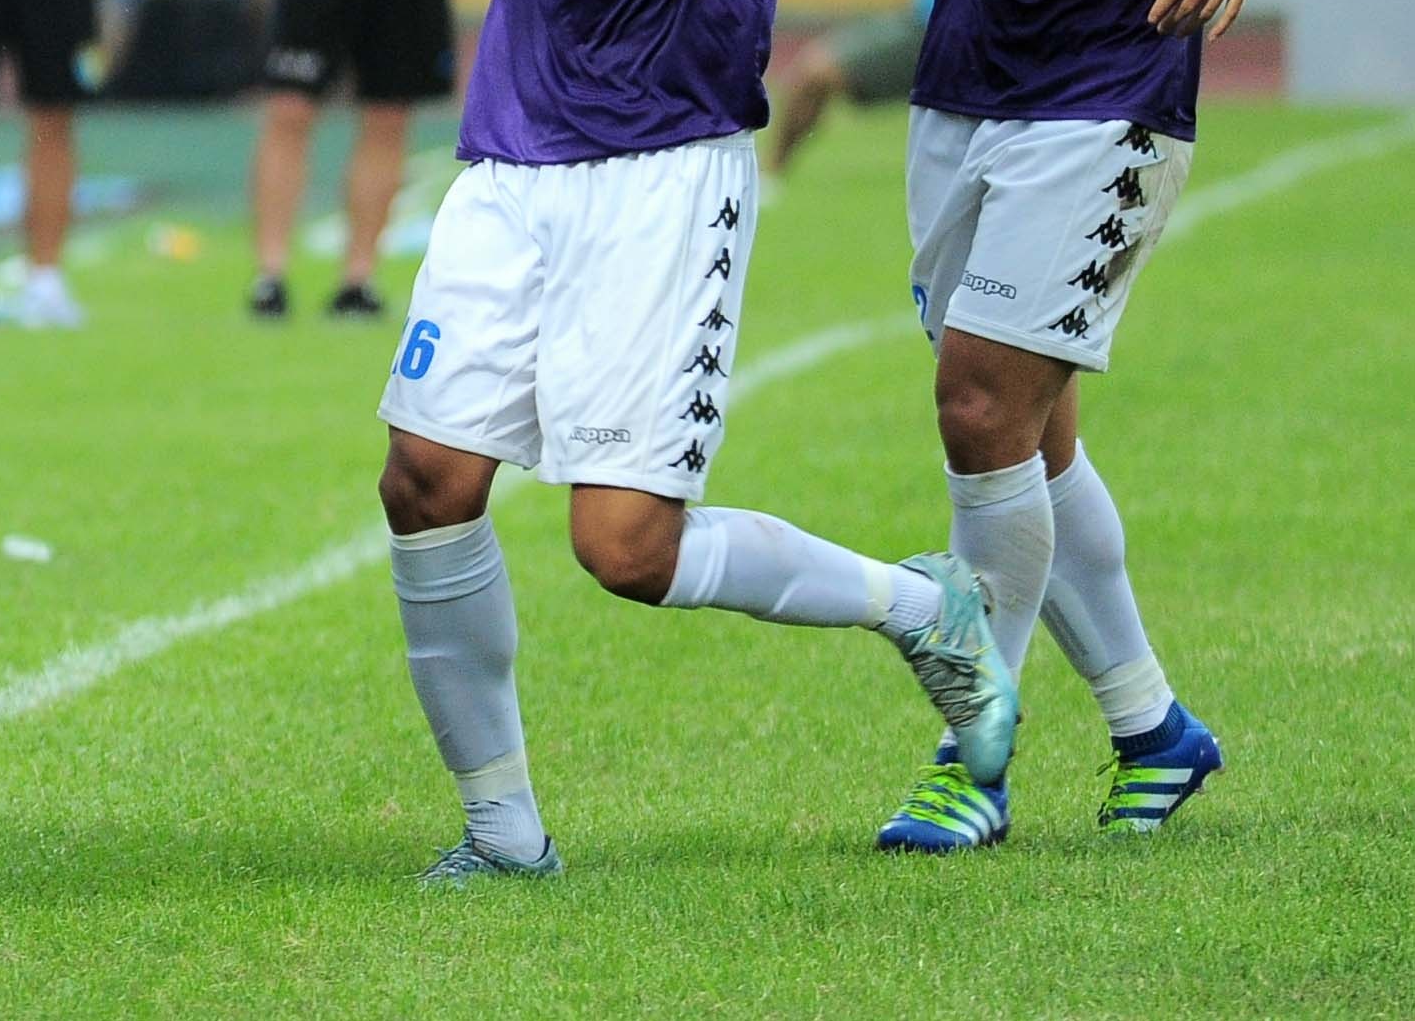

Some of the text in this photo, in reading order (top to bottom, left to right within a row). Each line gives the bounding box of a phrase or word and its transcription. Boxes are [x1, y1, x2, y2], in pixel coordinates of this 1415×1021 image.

[961, 270, 1017, 300] appa
[391, 317, 442, 381] 6
[569, 426, 632, 446] appa
